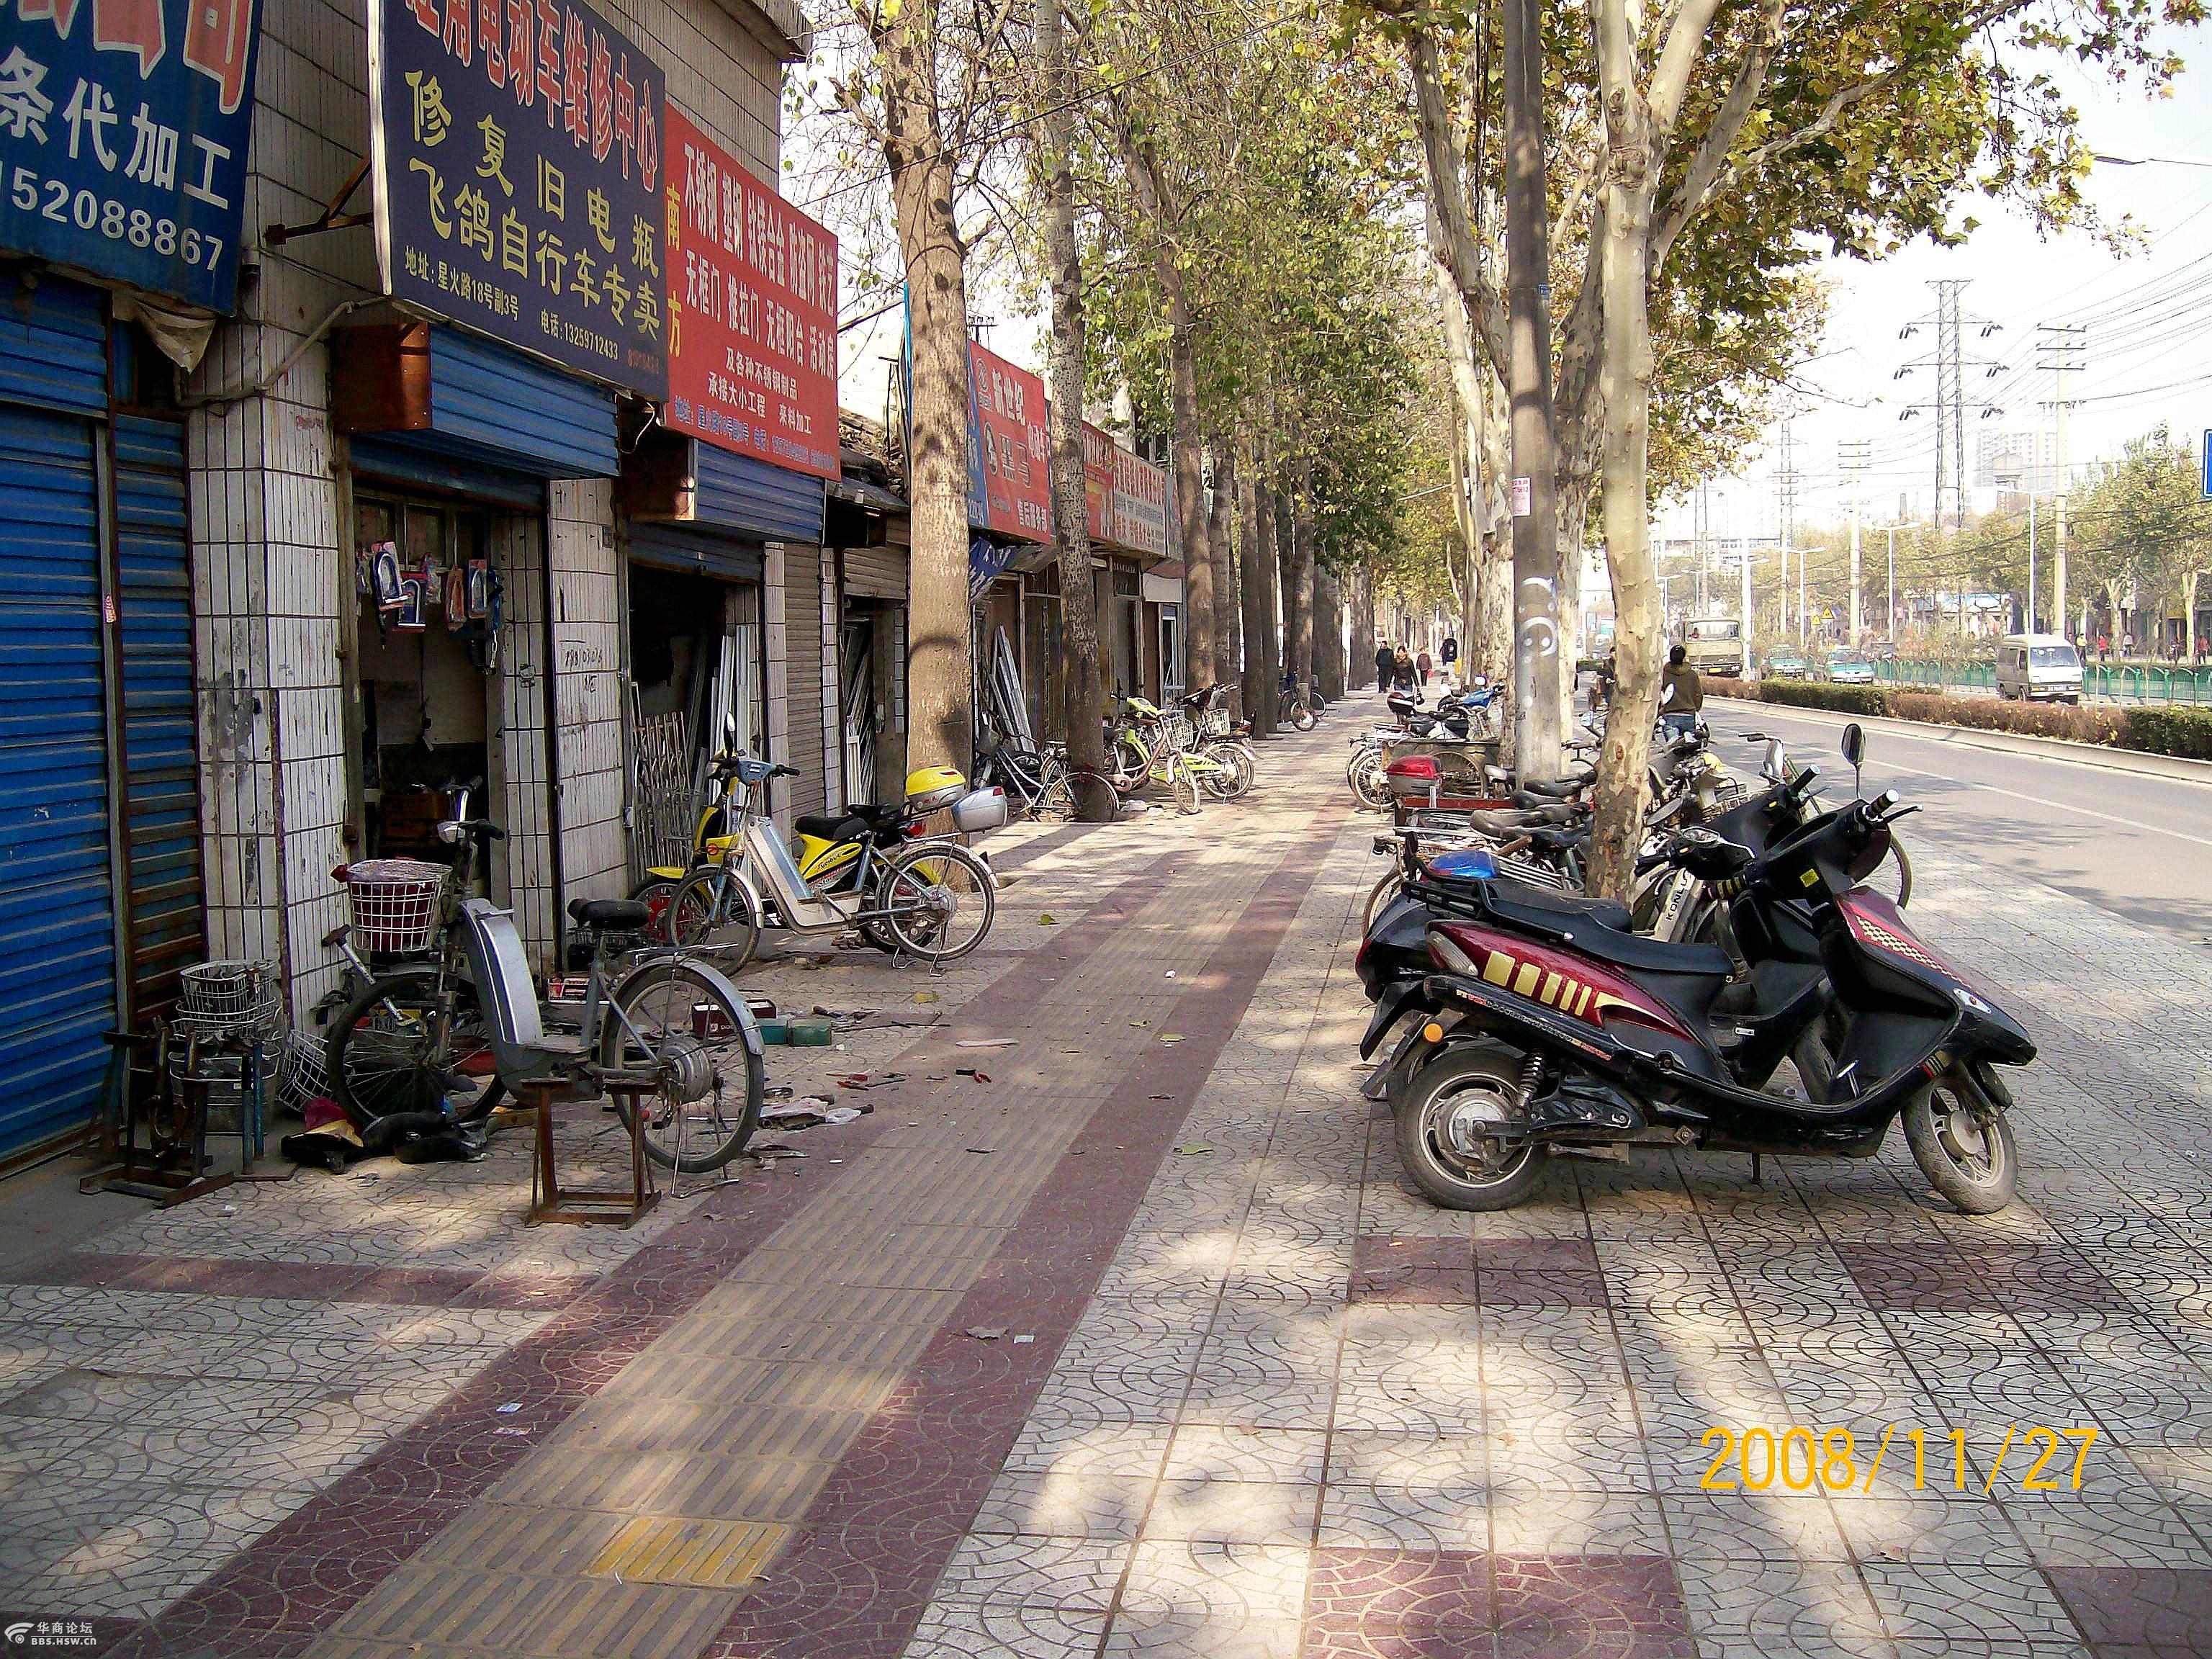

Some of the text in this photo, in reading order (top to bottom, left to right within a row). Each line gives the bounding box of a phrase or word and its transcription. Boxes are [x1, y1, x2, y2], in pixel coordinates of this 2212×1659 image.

[0, 45, 231, 210] 条代加工
[405, 69, 659, 279] 修复旧电瓶
[408, 157, 661, 341] 飞鸽自行车专卖
[666, 183, 683, 358] 南方
[686, 249, 721, 323] 无框门
[708, 371, 812, 435] 承接大小工程 来料加工
[725, 346, 798, 401] 及各种不锈钢制品
[999, 432, 1031, 488] 黑马
